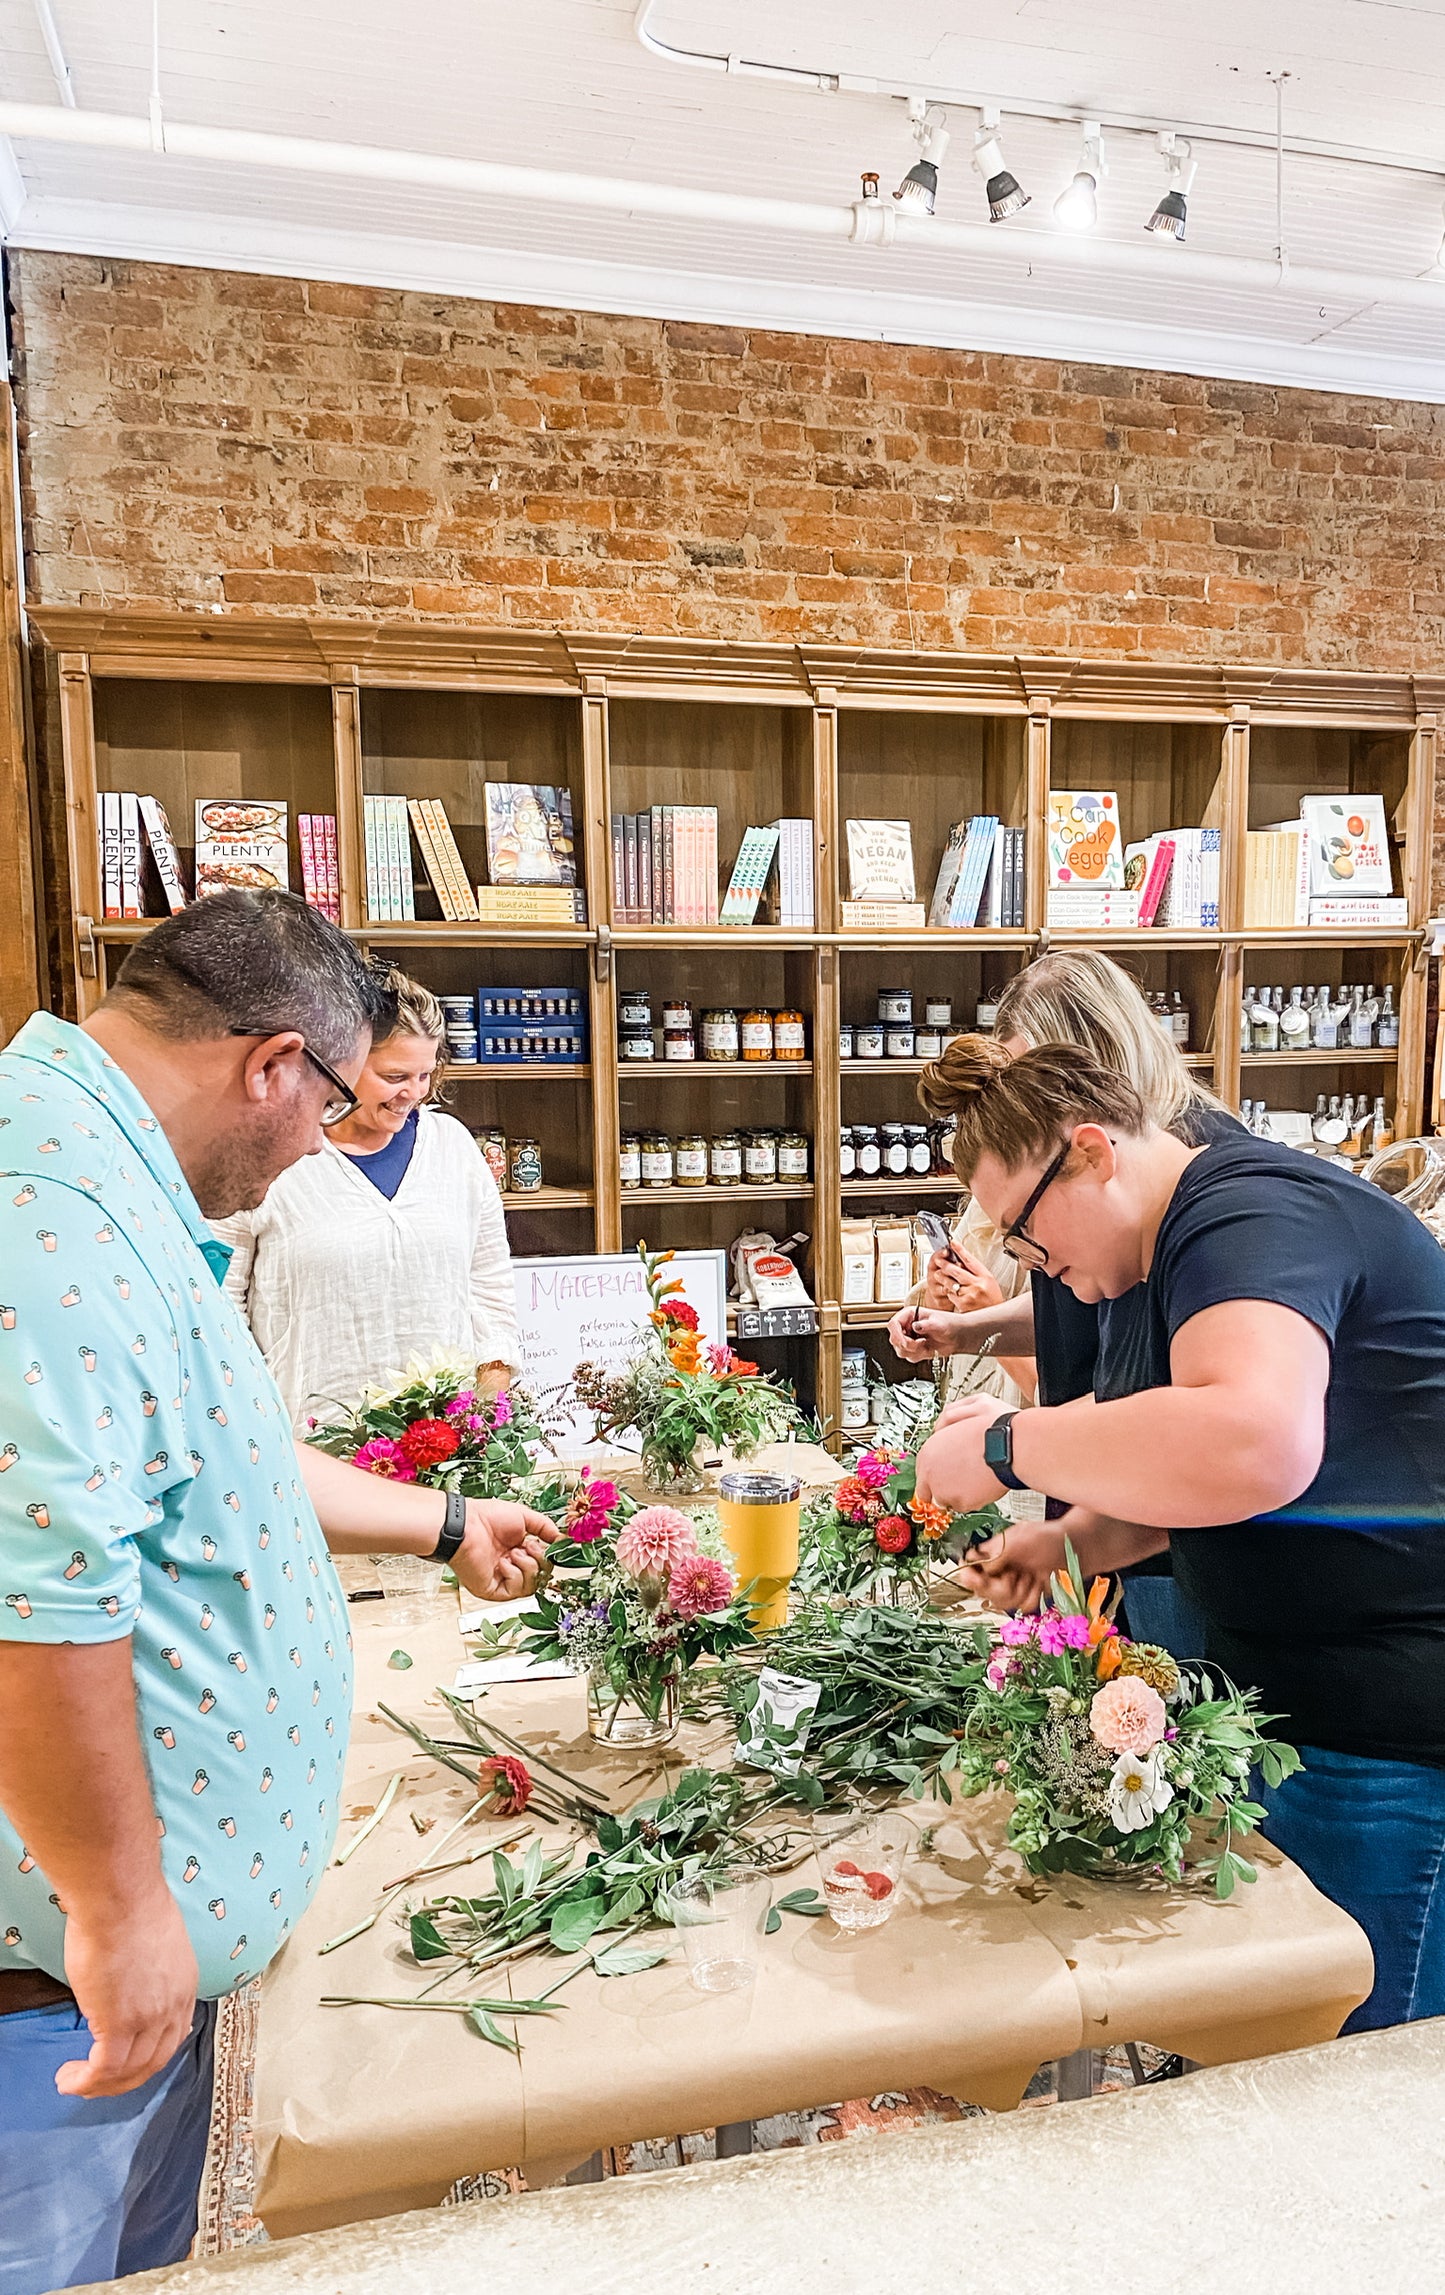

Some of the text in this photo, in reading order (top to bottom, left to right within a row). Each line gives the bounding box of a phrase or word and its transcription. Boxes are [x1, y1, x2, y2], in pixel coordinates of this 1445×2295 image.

[1056, 805, 1107, 823] I Can
[1060, 826, 1108, 844] Cook
[105, 829, 119, 888] PLENTY
[123, 829, 137, 888] PLENTY
[149, 830, 177, 889] PLENTY
[213, 845, 273, 856] PLENTY
[855, 846, 906, 860] VEGAN
[1056, 848, 1114, 870] Vegan
[866, 875, 899, 884] FRIENDS
[530, 1270, 667, 1311] MATERIAL
